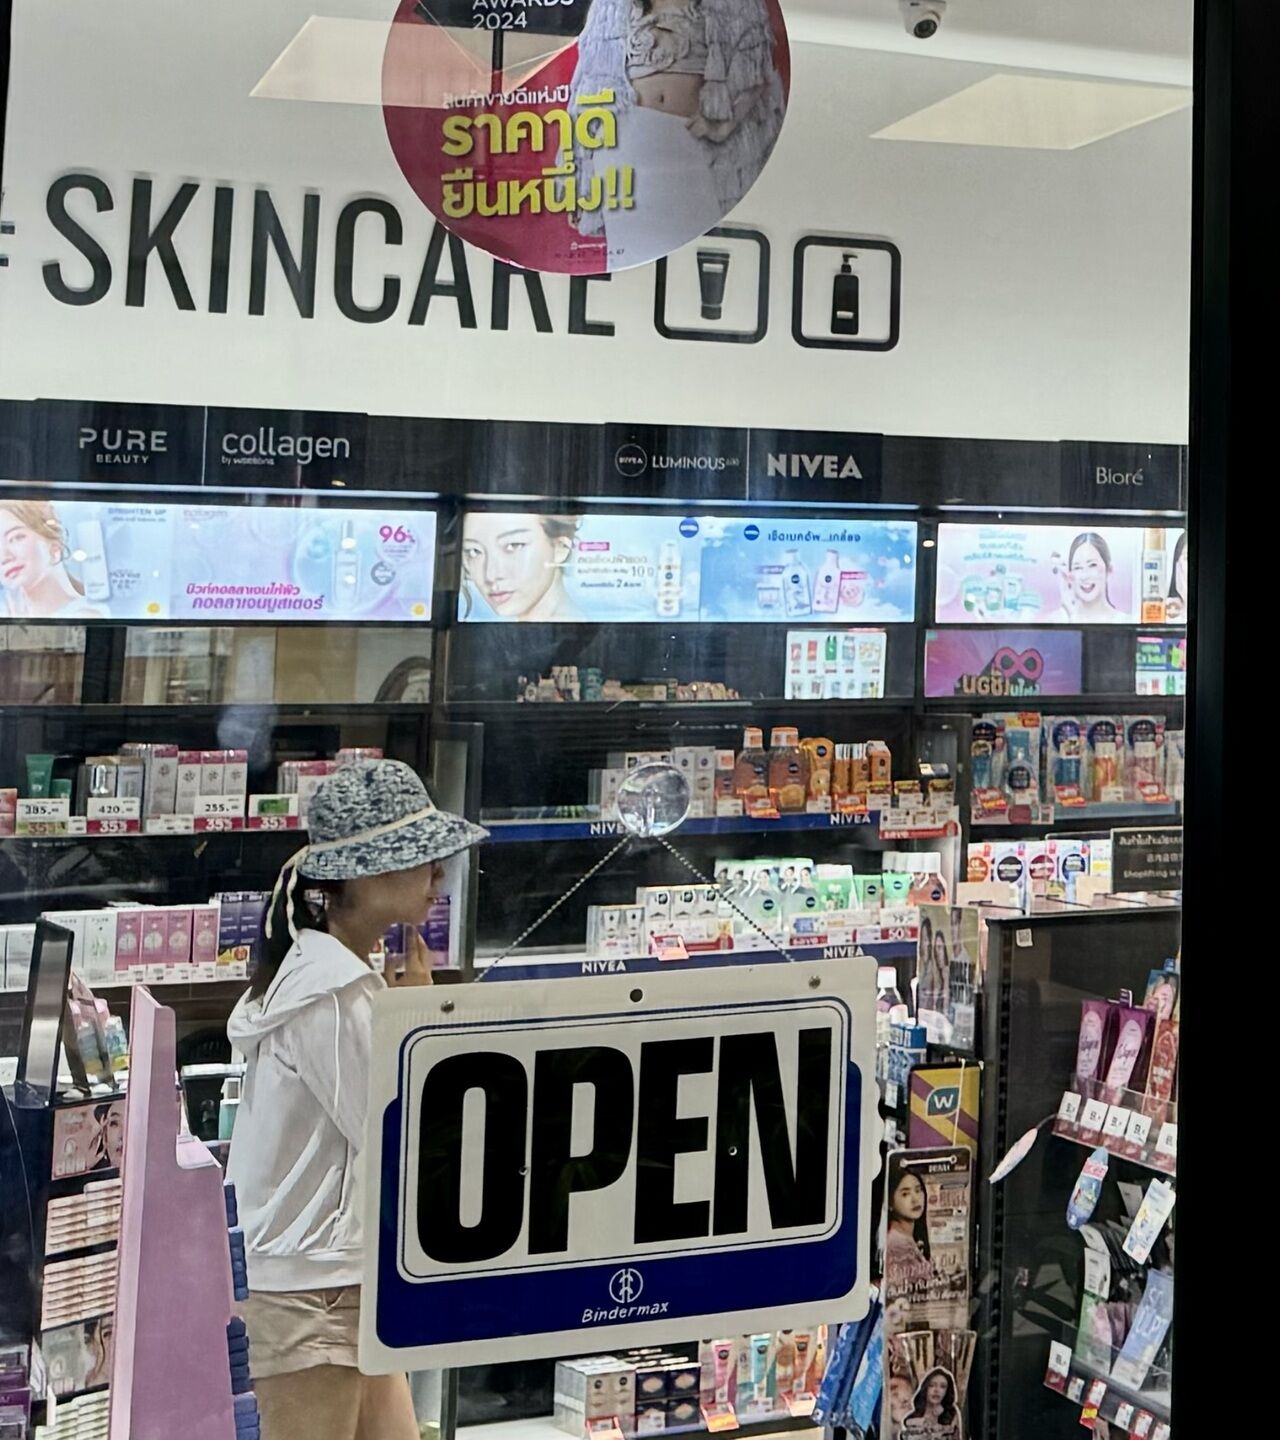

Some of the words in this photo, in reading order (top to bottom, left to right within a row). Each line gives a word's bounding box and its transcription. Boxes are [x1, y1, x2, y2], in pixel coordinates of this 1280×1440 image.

[473, 10, 527, 30] 2024
[441, 88, 616, 157] ราคาดี
[79, 427, 168, 453] PURE
[222, 427, 350, 464] collagen
[96, 454, 149, 464] BEAUTY
[767, 453, 863, 480] NIVEA
[1096, 466, 1144, 485] Bioré
[591, 822, 626, 835] NIVE
[830, 813, 871, 826] NIVEA
[824, 945, 865, 958] NIVEA
[582, 960, 627, 973] NIVEA
[933, 1093, 955, 1108] W
[416, 1026, 833, 1264] OPEN
[582, 1300, 669, 1323] Bindermax
